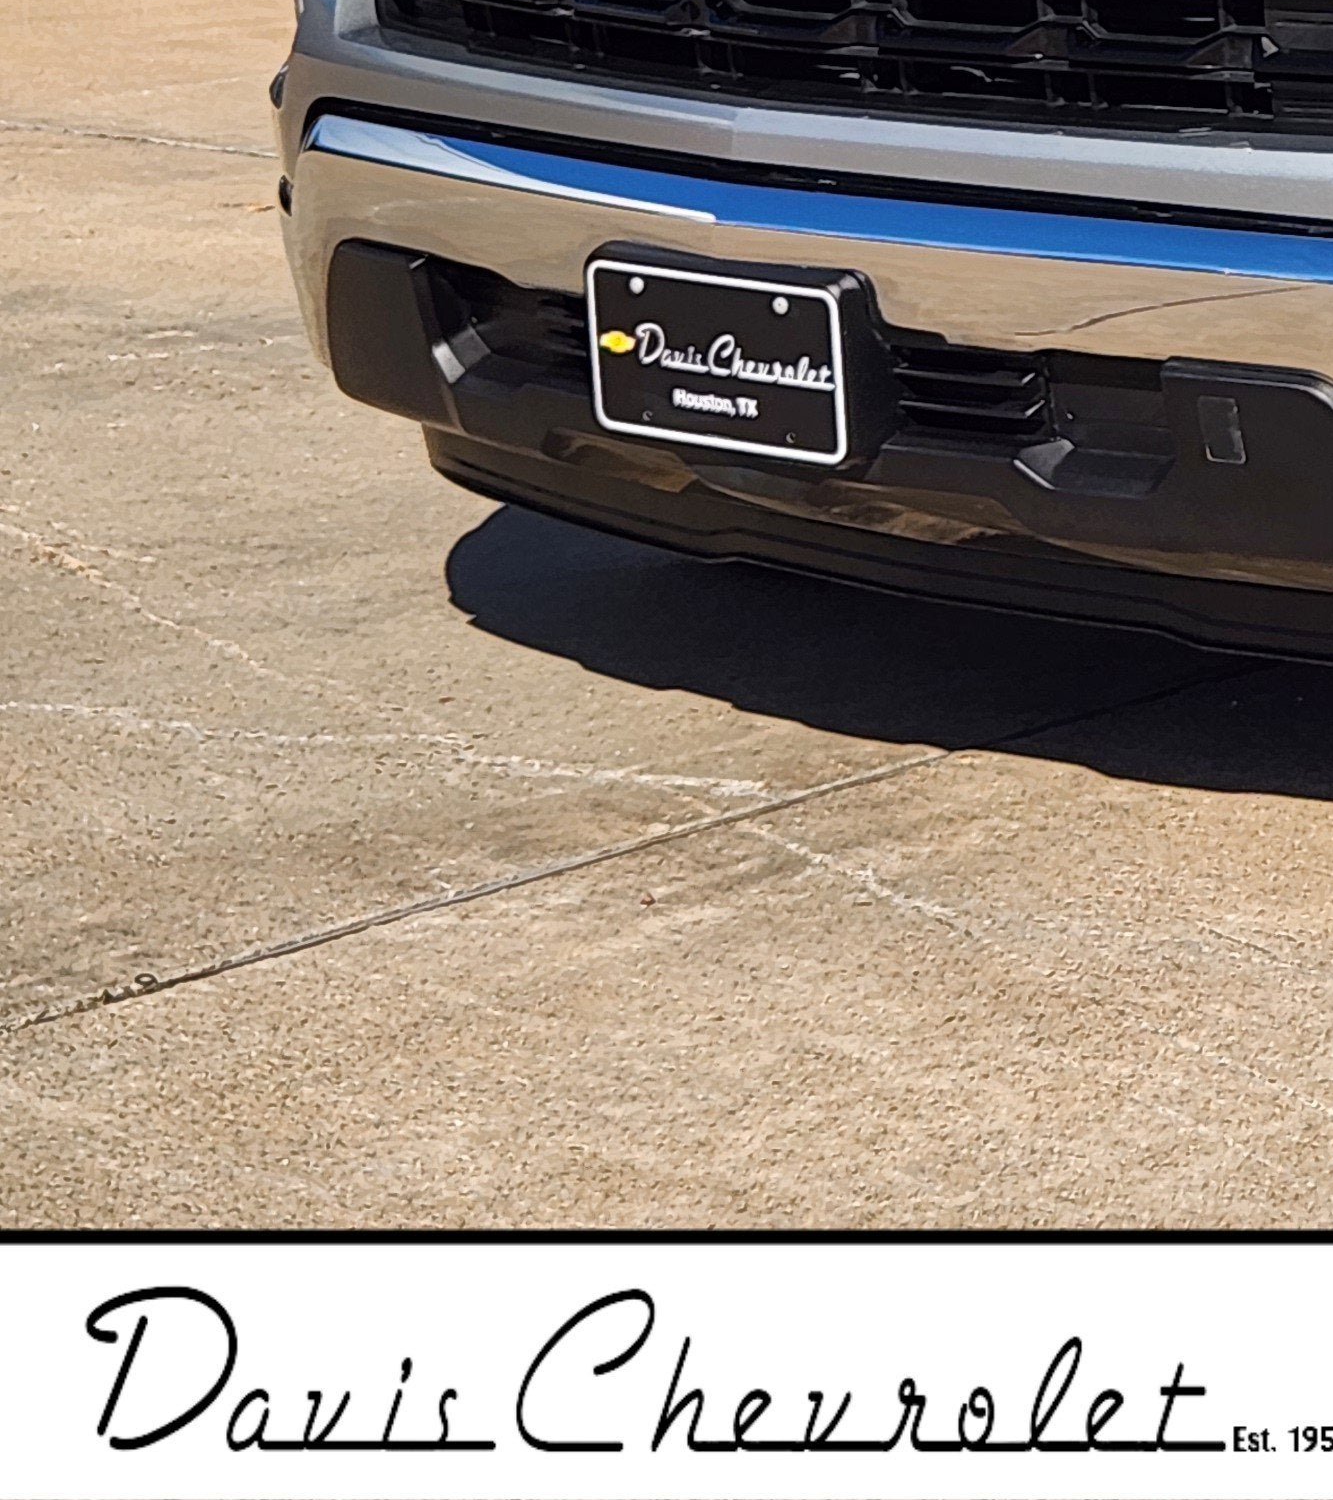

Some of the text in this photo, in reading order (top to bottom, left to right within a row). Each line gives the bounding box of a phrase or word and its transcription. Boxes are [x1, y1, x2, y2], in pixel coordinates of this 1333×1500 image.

[635, 322, 836, 391] Davis Chevrolet
[672, 387, 759, 419] Houston, TX
